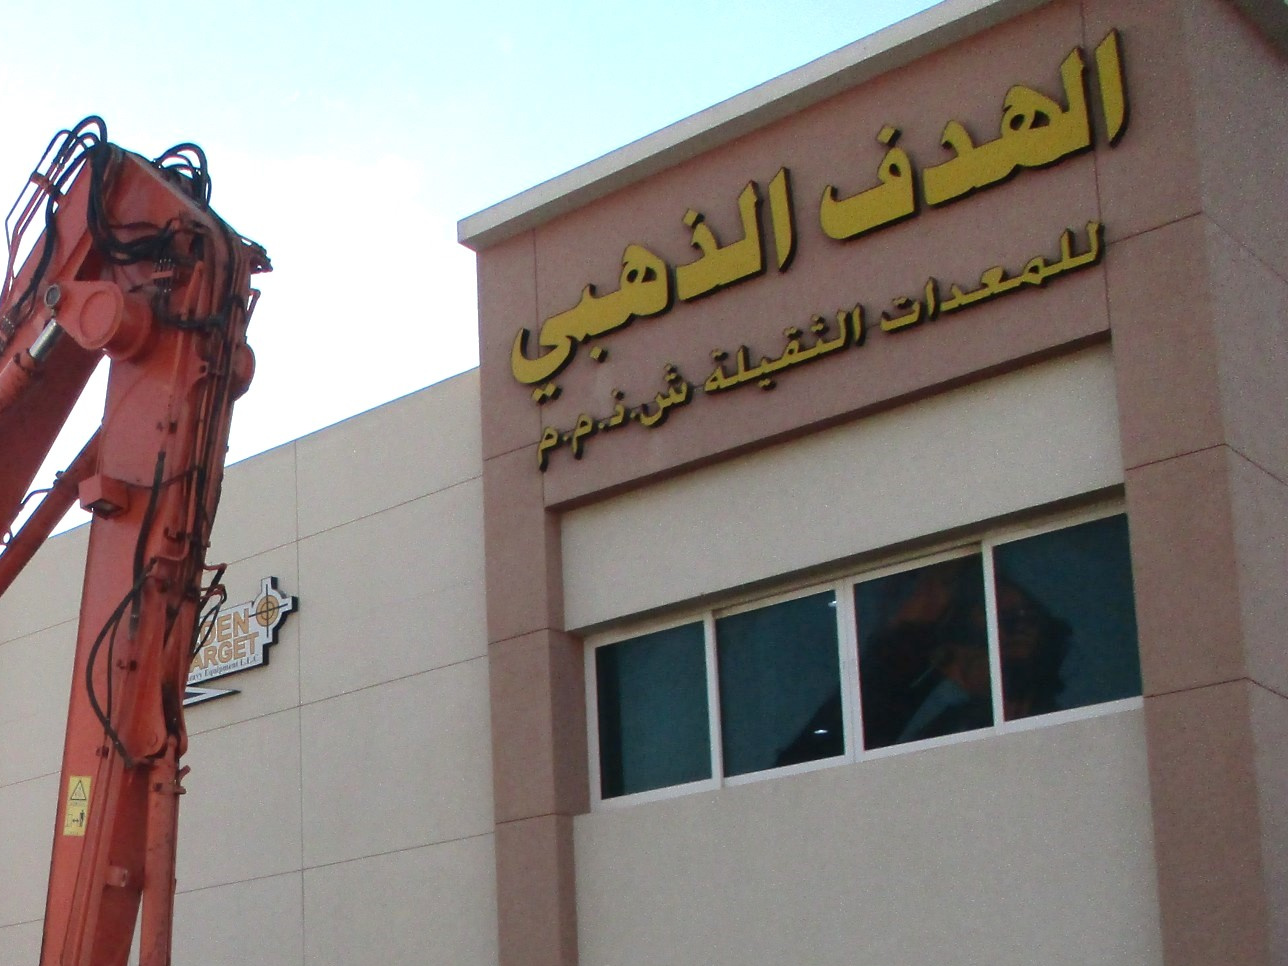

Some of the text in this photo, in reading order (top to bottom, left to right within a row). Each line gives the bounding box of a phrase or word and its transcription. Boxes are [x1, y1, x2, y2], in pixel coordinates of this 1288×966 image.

[511, 27, 1128, 405] الهدف الذهبي
[879, 220, 1106, 335] للمعدات
[703, 302, 868, 395] الثقيلة
